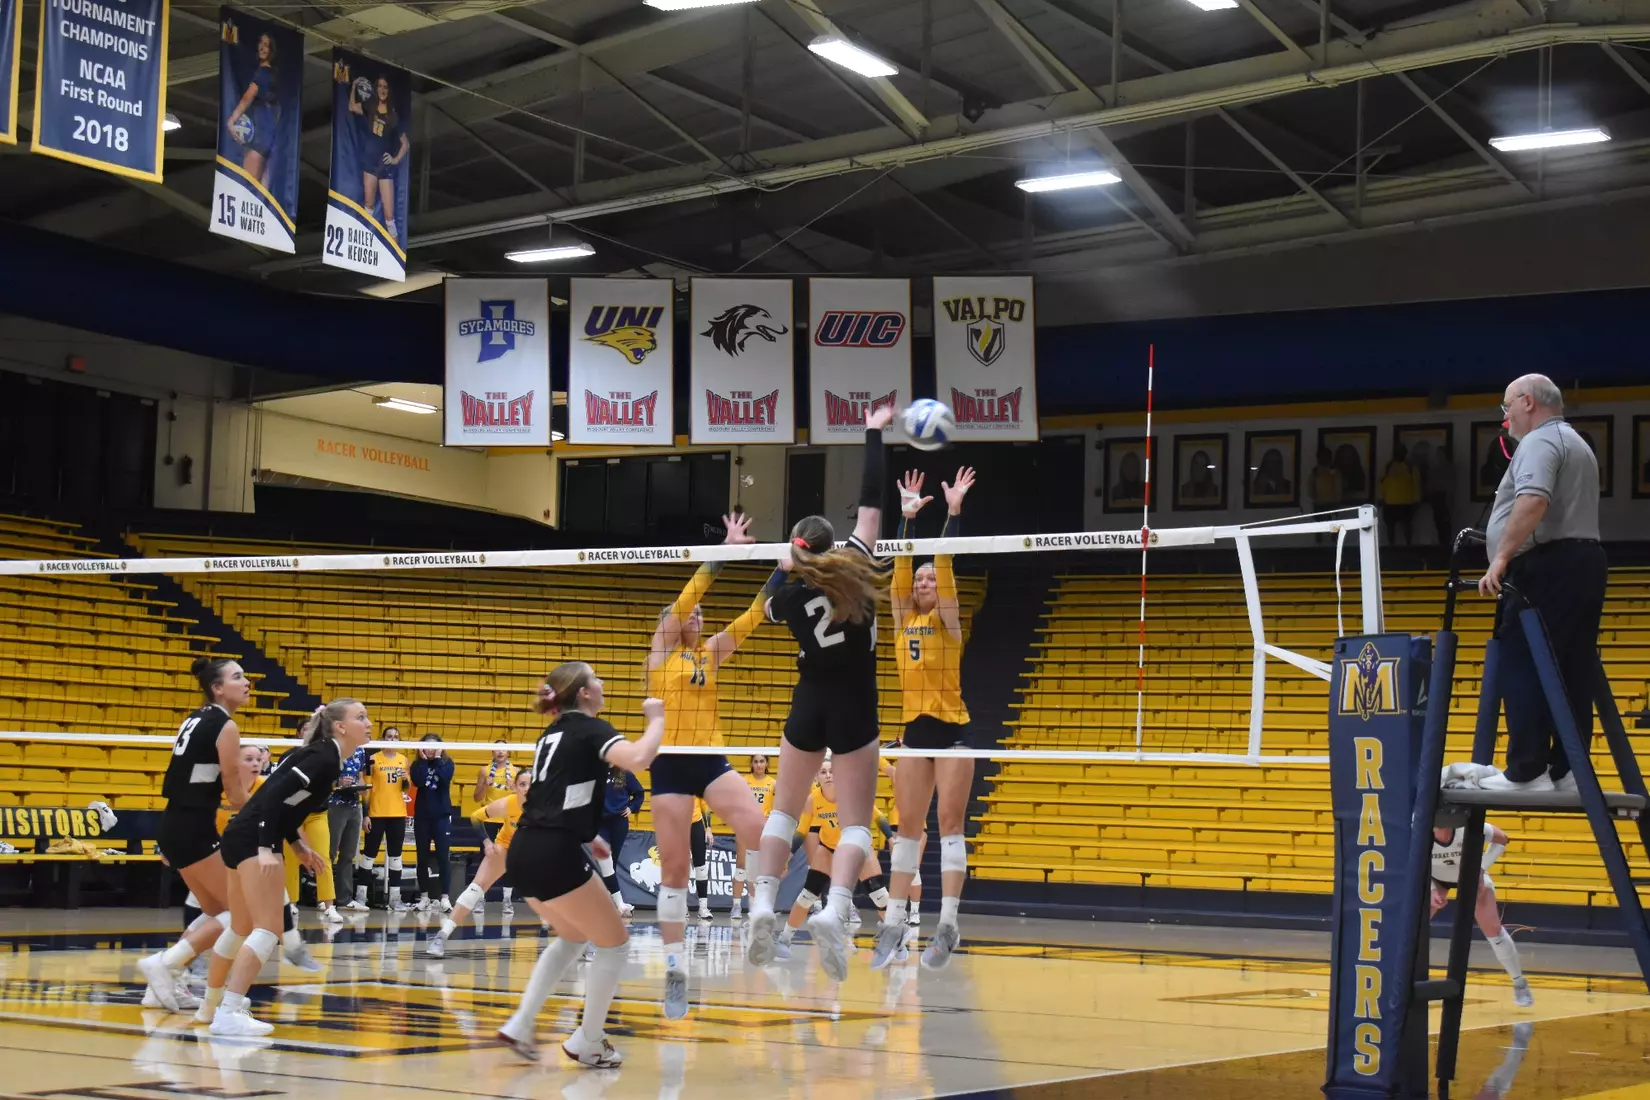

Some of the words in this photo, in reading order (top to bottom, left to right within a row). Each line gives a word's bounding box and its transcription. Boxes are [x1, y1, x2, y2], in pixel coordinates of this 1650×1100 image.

[60, 20, 148, 61] CHAMPIONS
[79, 59, 126, 91] NCAA
[60, 79, 95, 104] First
[97, 89, 143, 117] Round
[72, 115, 129, 152] 2018
[218, 193, 236, 227] 15
[240, 216, 265, 235] WATTS
[348, 227, 374, 248] BAILEY
[326, 224, 344, 257] 22
[584, 306, 665, 336] UNI
[942, 297, 1026, 322] VALPO
[460, 319, 535, 336] SYCAMORES
[817, 313, 903, 346] UIC
[484, 392, 508, 400] THE
[609, 392, 632, 400] THE
[730, 391, 753, 399] THE
[849, 392, 871, 400] THE
[951, 386, 1023, 423] VALLEY
[974, 389, 998, 397] THE
[460, 389, 535, 427] VALLEY
[585, 389, 659, 427] VALLEY
[706, 389, 779, 426] VALLEY
[317, 438, 356, 458] RACER
[361, 446, 430, 471] VOLLEYBALL
[588, 551, 619, 561] RACER
[620, 549, 681, 560] VOLLEYBALL
[1036, 537, 1072, 547] RACER
[46, 563, 71, 571] RACER
[72, 562, 119, 571] VOLLEYBALL
[213, 560, 238, 568] RACER
[240, 558, 291, 567] VOLLEYBALL
[392, 556, 420, 565] RACER
[423, 555, 477, 564] VOLLEYBALL
[804, 595, 846, 648] 2
[909, 639, 920, 661] 5
[532, 732, 564, 783] 17
[387, 772, 398, 784] 15
[0, 808, 100, 836] ISITORS
[1353, 737, 1386, 1076] RACERS
